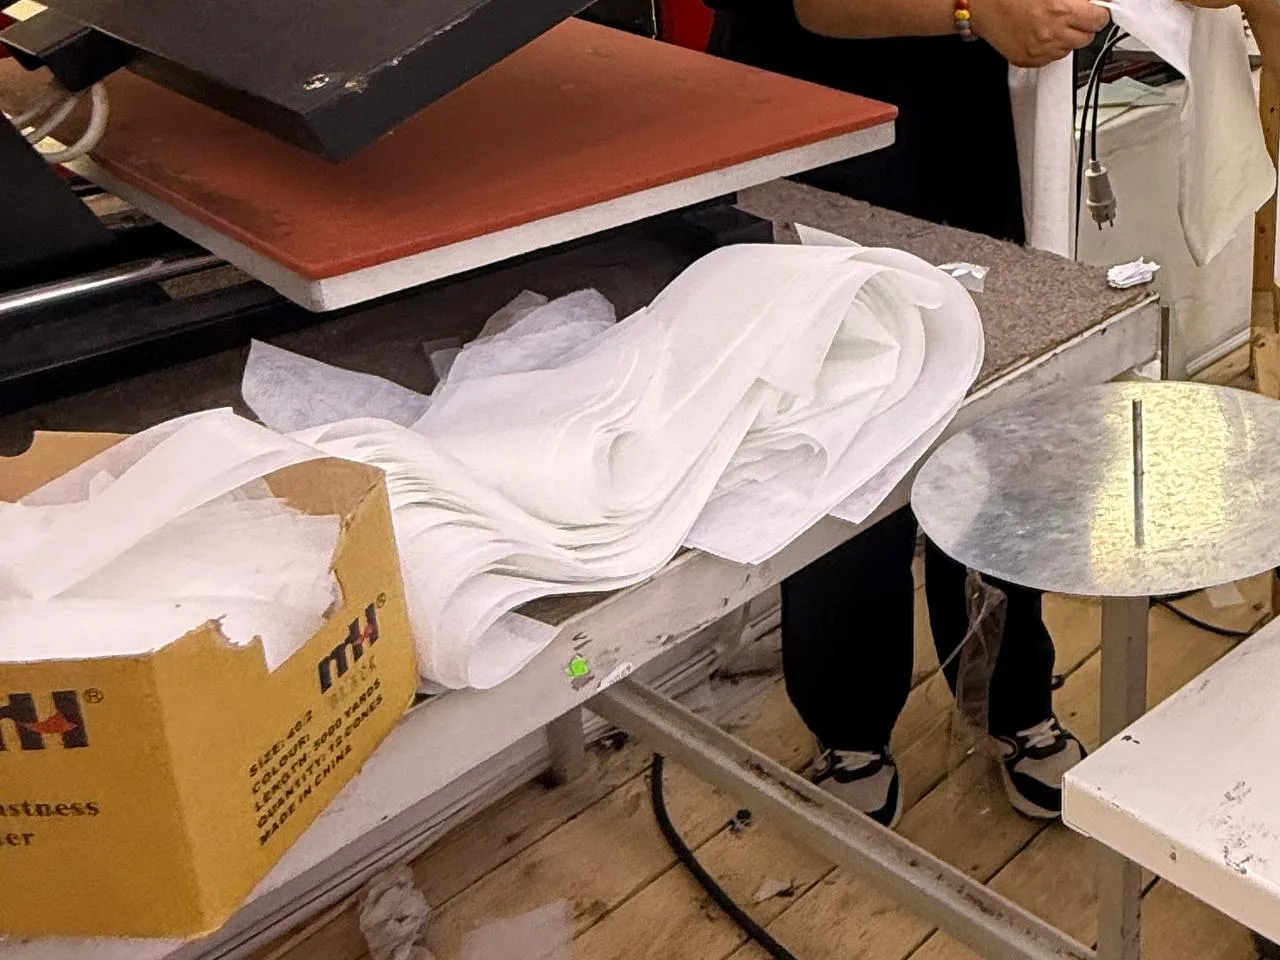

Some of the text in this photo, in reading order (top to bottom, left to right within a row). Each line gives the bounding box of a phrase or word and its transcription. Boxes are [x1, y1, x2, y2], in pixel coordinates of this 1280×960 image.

[313, 718, 342, 752] 5000
[344, 678, 381, 719] YARDS
[344, 693, 383, 737] CONES
[252, 734, 310, 794] COLOUR:
[260, 744, 352, 846] MADE IN CHINA
[0, 833, 34, 847] er
